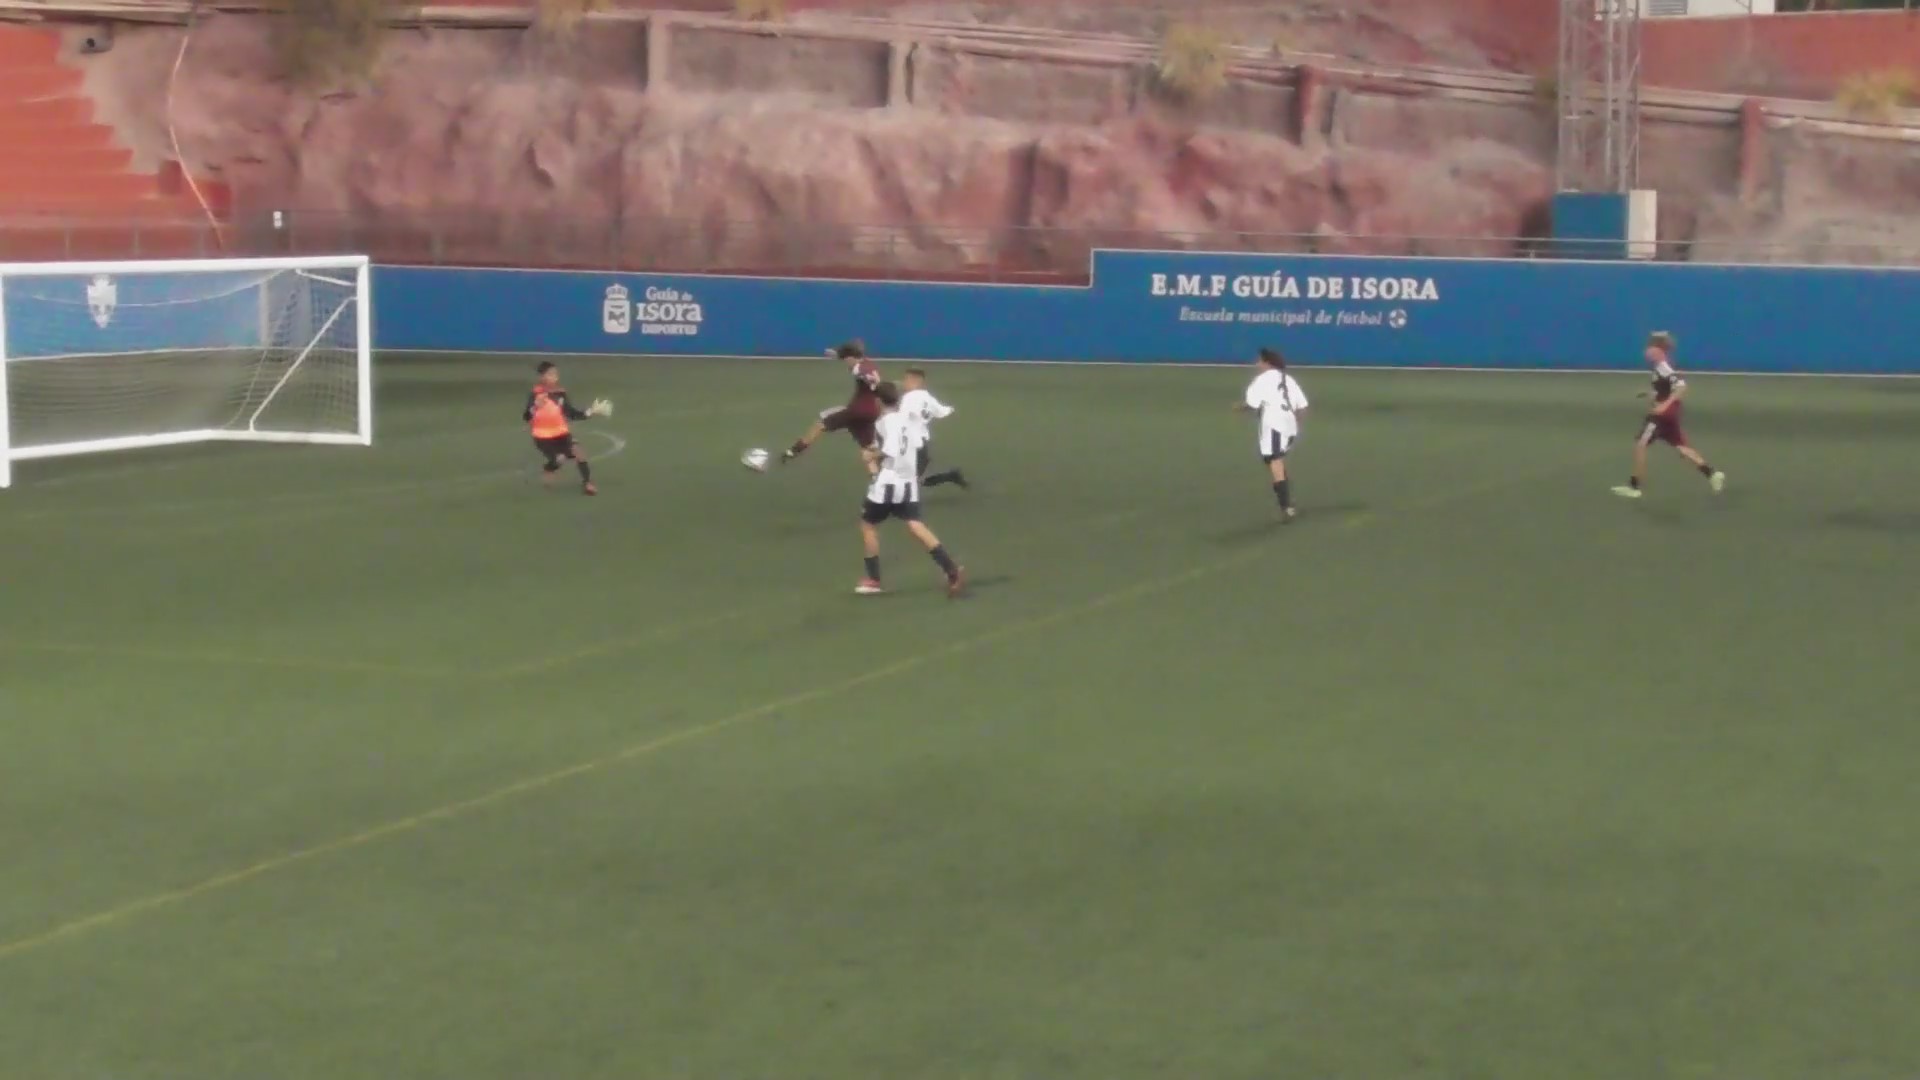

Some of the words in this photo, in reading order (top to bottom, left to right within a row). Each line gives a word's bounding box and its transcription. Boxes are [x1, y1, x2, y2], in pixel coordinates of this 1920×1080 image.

[1151, 273, 1227, 297] E.M.F
[1232, 270, 1300, 298] GUÍA
[1307, 276, 1344, 299] DE
[1350, 277, 1439, 301] ISORA
[1180, 306, 1234, 321] Escuela
[1239, 310, 1312, 326] municipal
[1315, 309, 1332, 324] de
